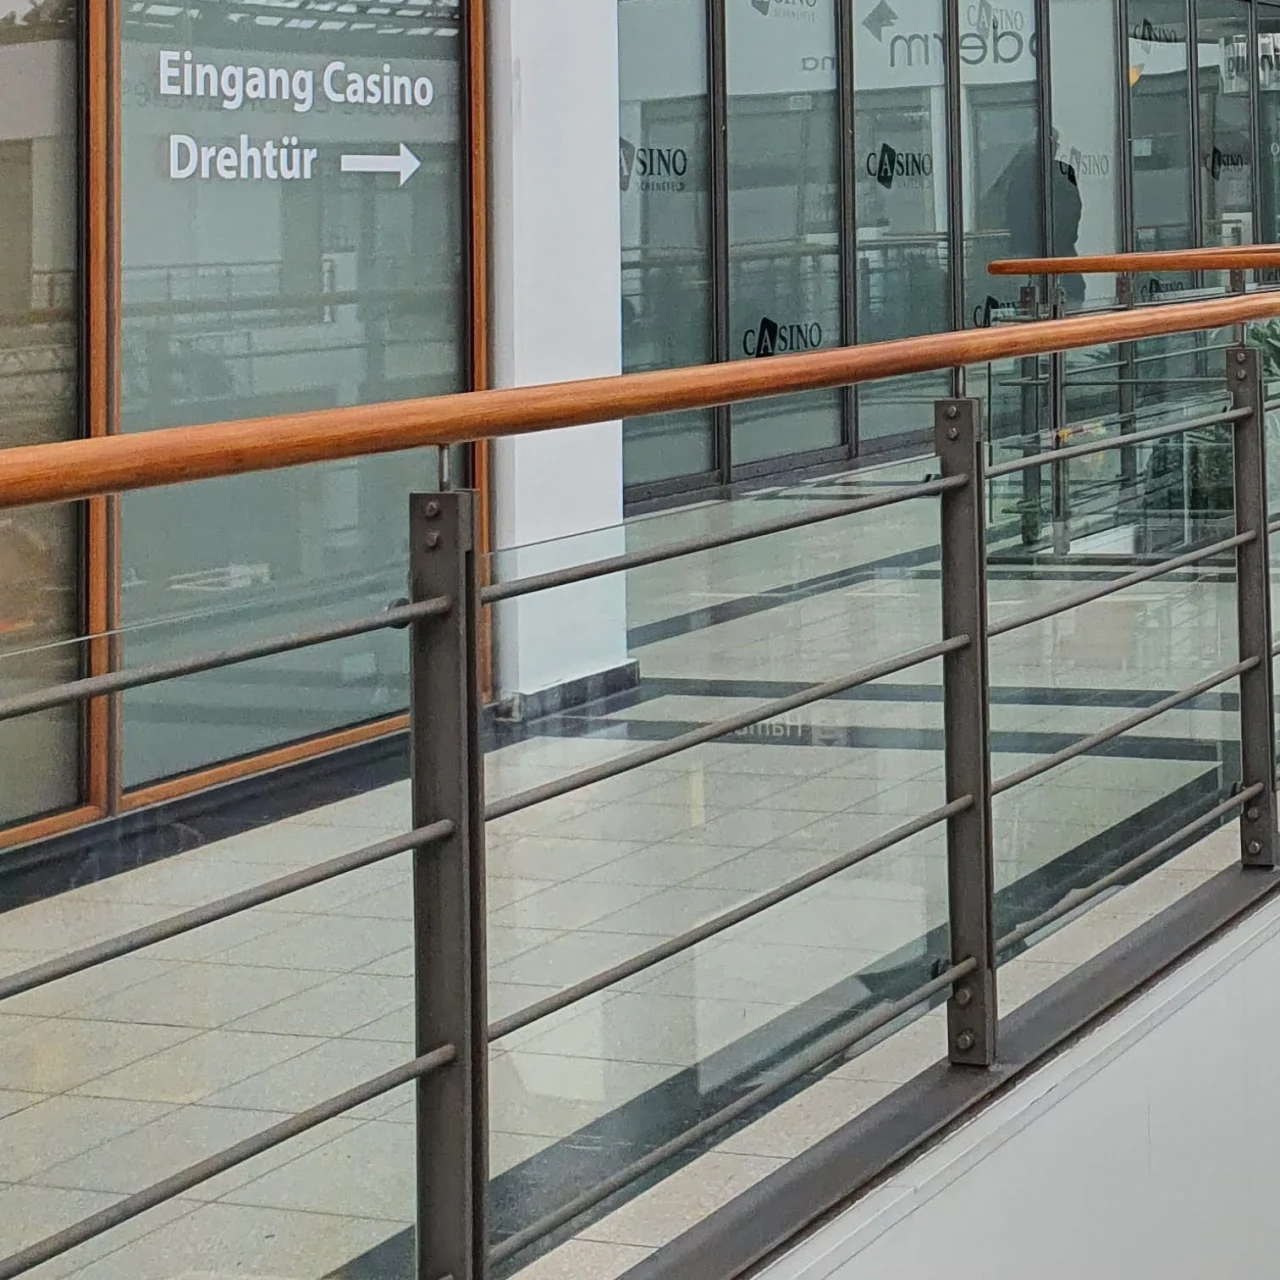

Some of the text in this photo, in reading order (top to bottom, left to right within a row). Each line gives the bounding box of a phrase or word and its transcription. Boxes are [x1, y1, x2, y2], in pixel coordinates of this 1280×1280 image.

[159, 50, 434, 112] Eingang Casino
[169, 134, 318, 180] Drehtür
[866, 151, 933, 178] CASINO
[742, 321, 823, 357] CASINO
